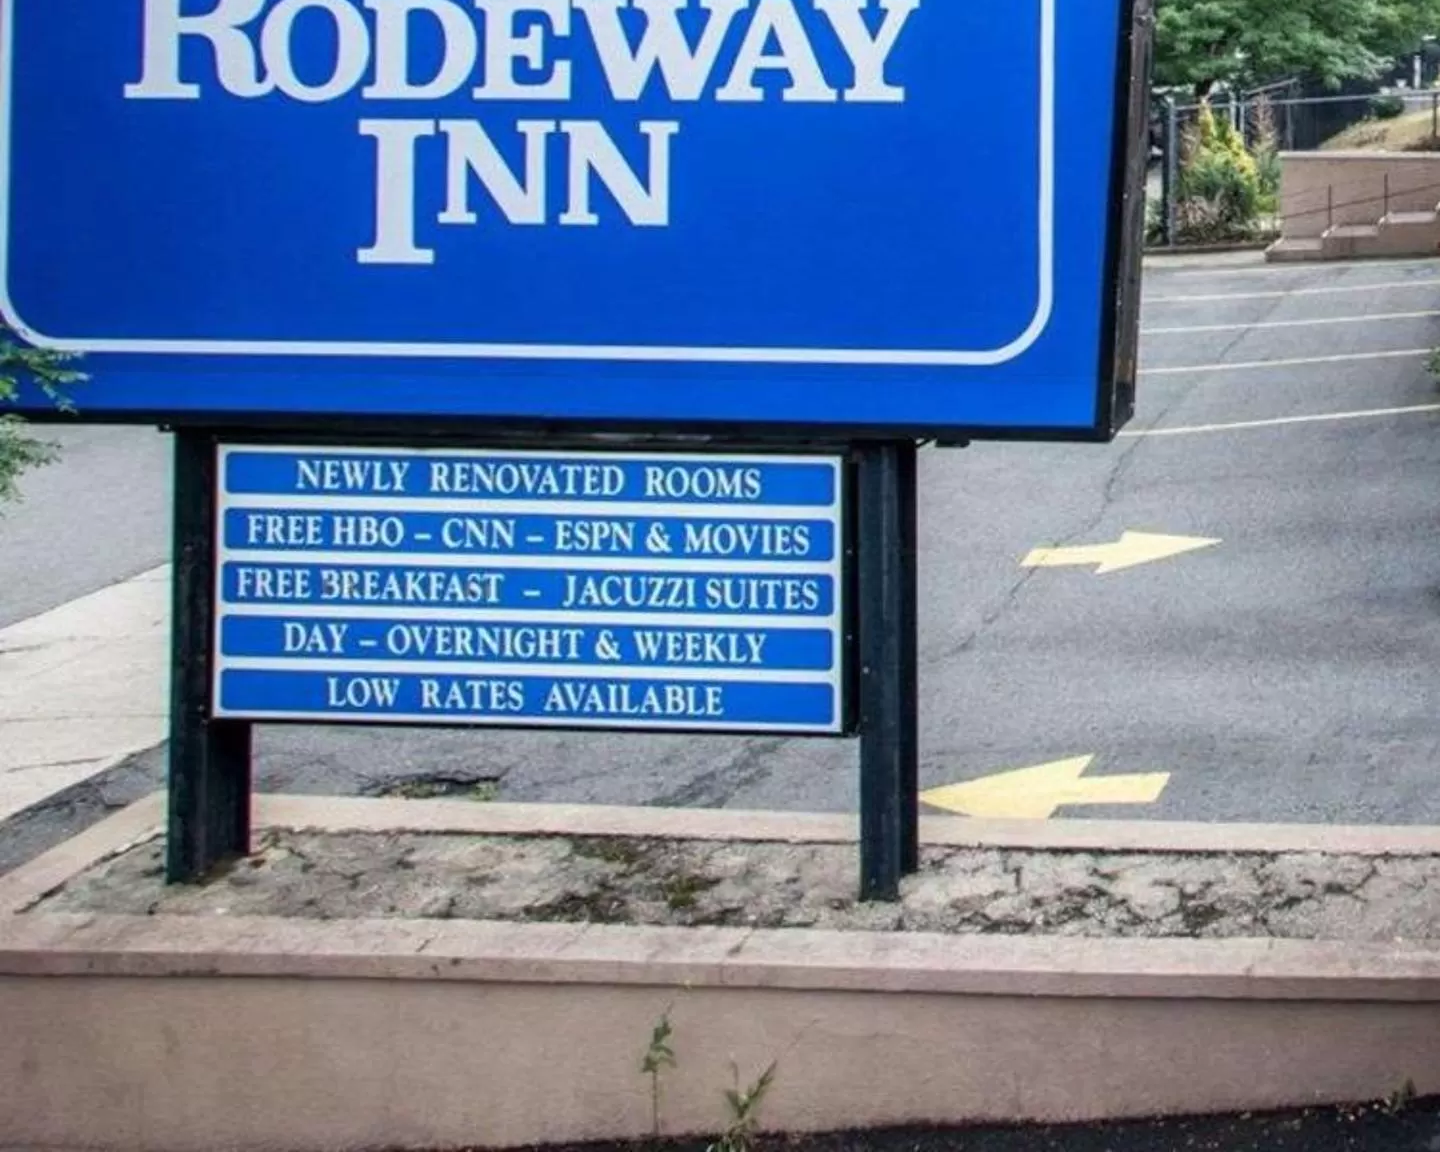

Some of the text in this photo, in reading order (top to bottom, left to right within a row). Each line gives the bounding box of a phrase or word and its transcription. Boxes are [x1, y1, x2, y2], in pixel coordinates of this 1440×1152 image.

[358, 119, 679, 264] INN
[297, 460, 760, 498] NEWLY RENOVATED ROOMS
[248, 515, 322, 544] FREE
[333, 516, 404, 546] HBO
[442, 518, 514, 548] CNN
[556, 521, 634, 550] ESPN
[646, 522, 671, 553] &
[685, 524, 809, 554] MOVIES
[239, 568, 309, 598] FREE
[321, 569, 503, 602] BREAKFAST
[563, 575, 694, 607] JACUZZI
[706, 579, 818, 609] SUITES
[285, 623, 346, 652] DAY
[387, 625, 583, 658] OVERNIGHT
[595, 630, 621, 660] &
[634, 631, 765, 663] WEEKLY
[328, 678, 722, 715] LOW RATES AVAILABLE
